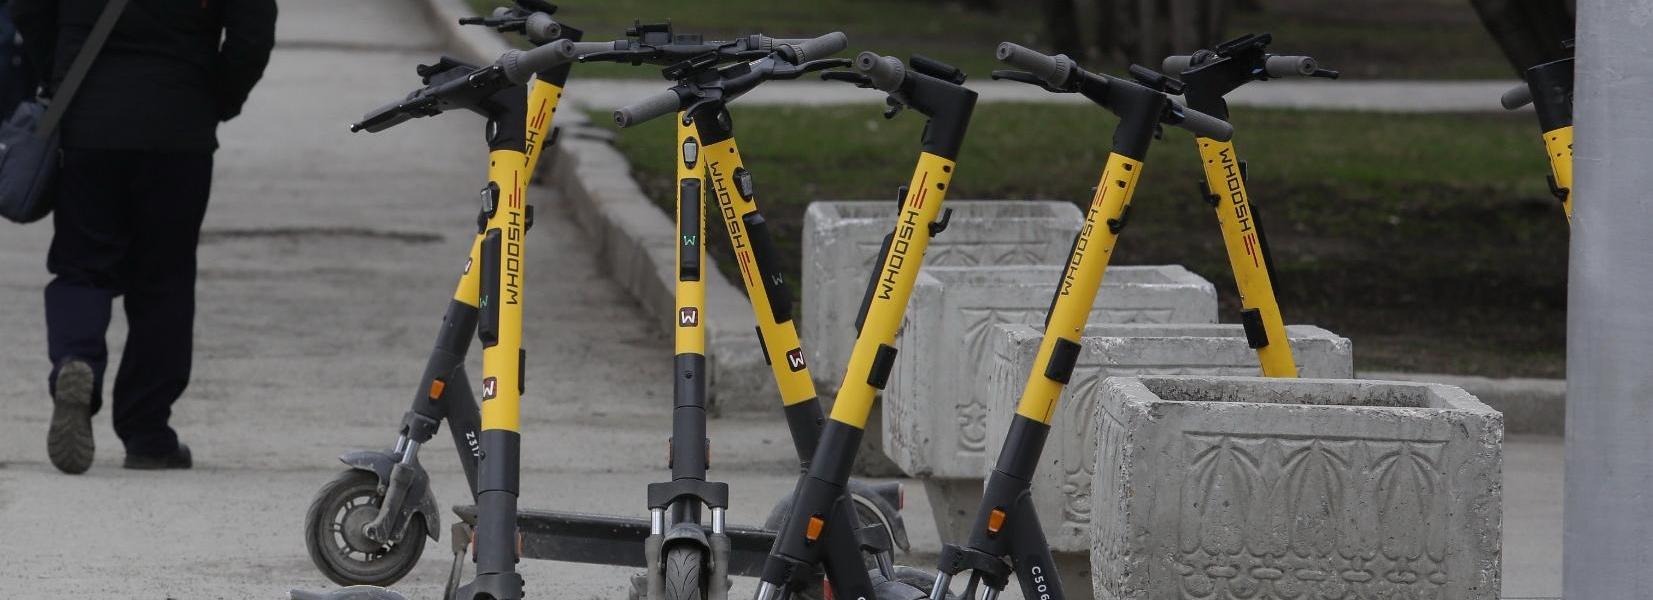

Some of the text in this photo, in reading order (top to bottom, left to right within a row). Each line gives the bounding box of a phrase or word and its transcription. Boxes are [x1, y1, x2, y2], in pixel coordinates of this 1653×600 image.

[710, 161, 745, 249] WHOOSH
[1219, 148, 1252, 233] WHOOSH
[506, 211, 521, 305] WHOOSH
[878, 210, 919, 300] WHOOSH
[1061, 208, 1098, 296] WHOOSH
